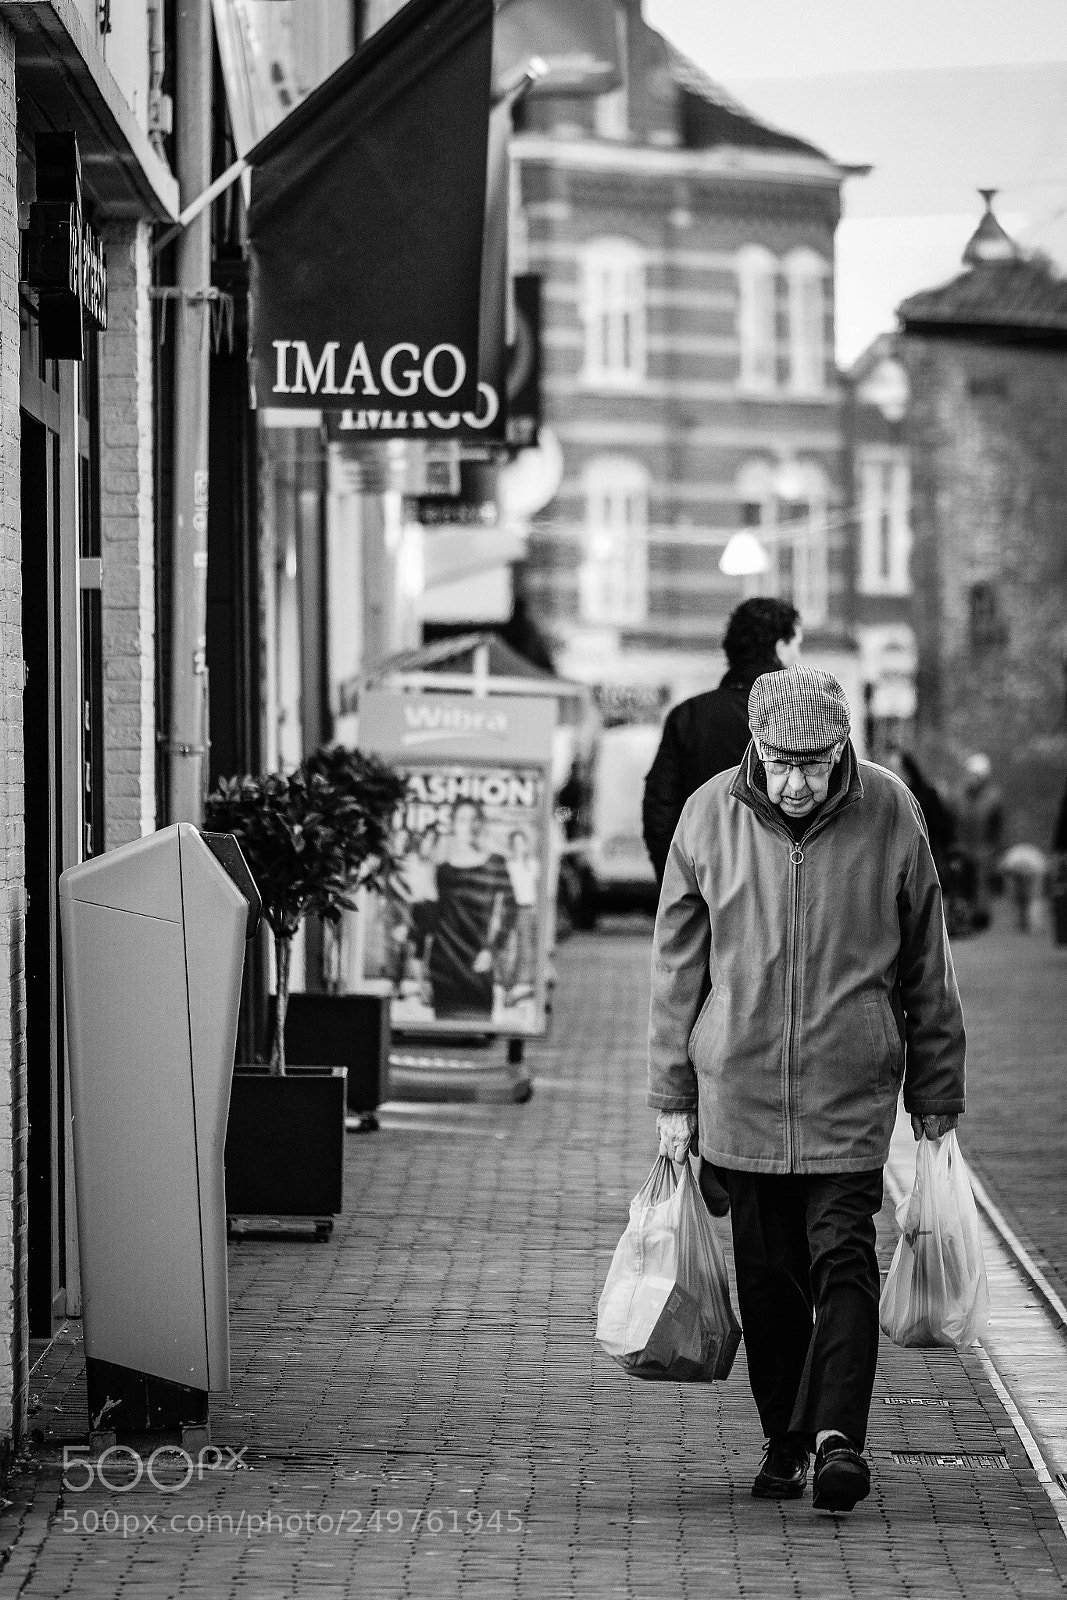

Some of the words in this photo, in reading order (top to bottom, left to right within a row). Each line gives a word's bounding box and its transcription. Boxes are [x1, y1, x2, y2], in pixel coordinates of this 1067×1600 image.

[272, 340, 466, 397] IMAGO
[404, 705, 507, 732] Wibra
[404, 774, 534, 806] ASHION
